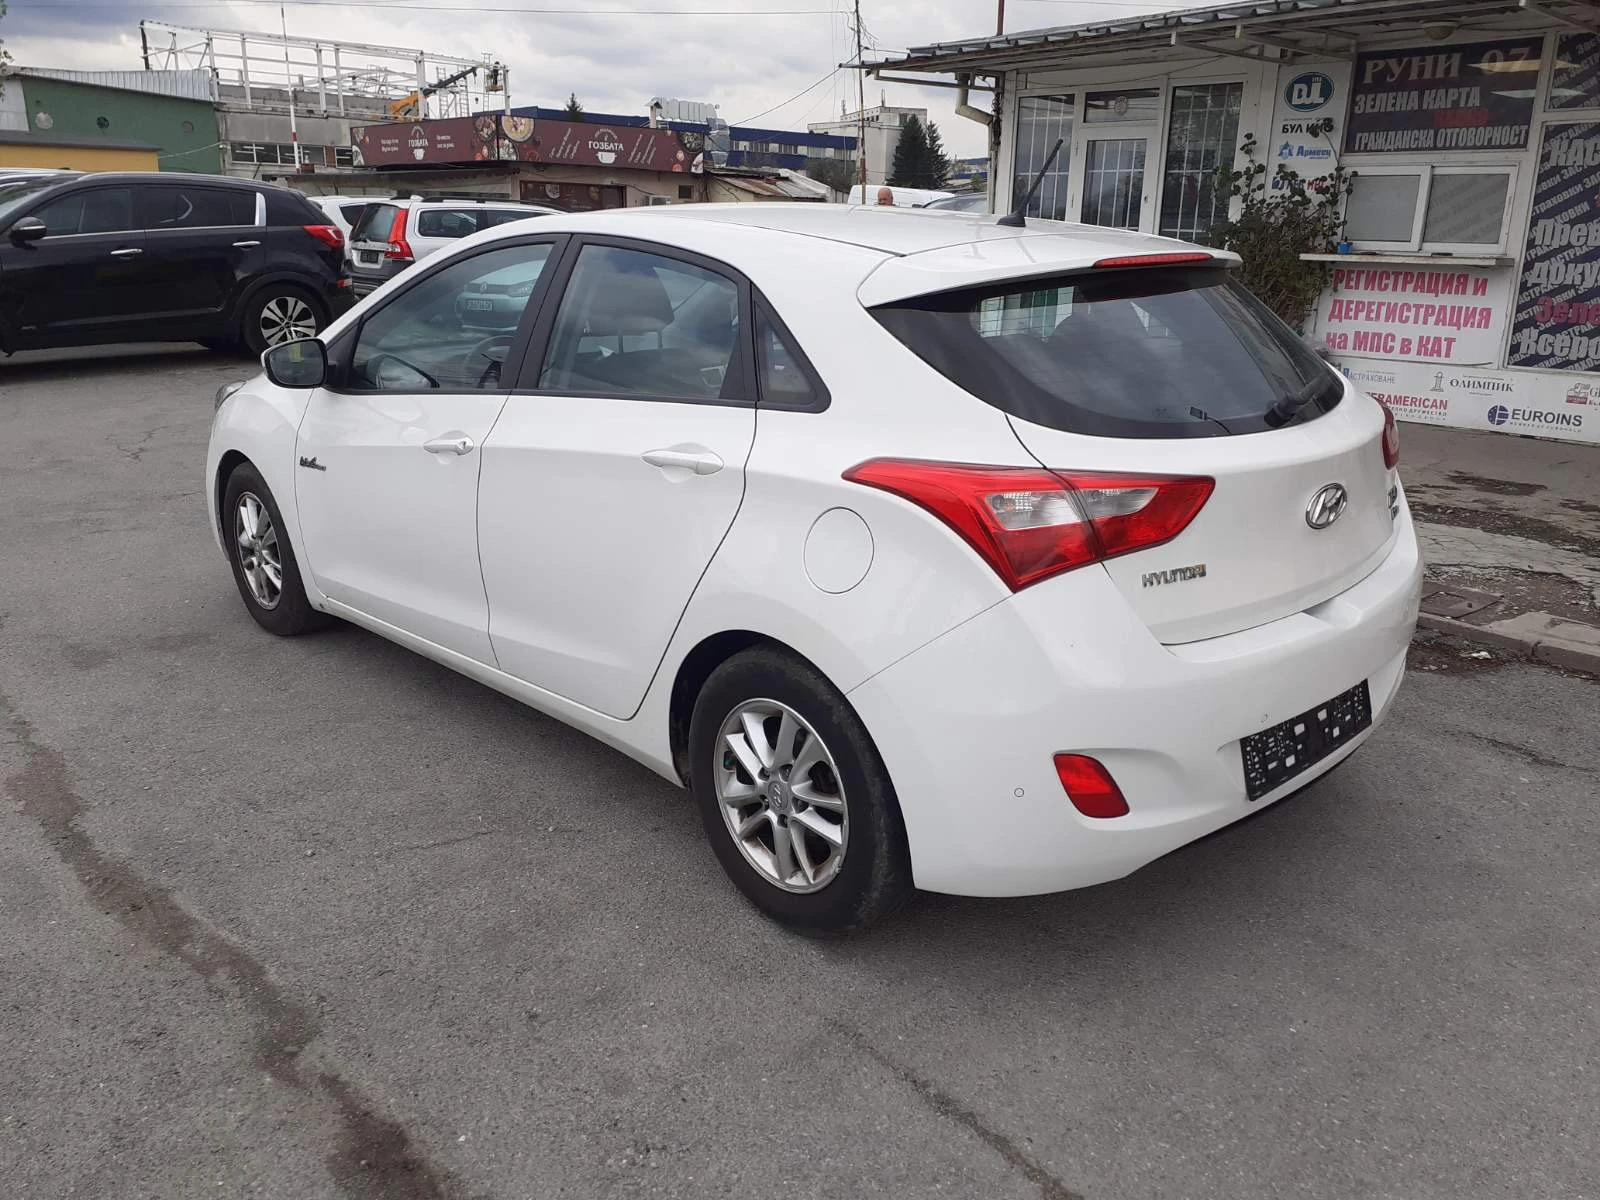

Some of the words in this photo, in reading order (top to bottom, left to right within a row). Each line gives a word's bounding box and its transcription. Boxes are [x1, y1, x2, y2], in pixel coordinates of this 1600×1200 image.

[1363, 53, 1463, 84] РУНИ
[1354, 91, 1418, 114] ЗЕЛЕНА
[1422, 87, 1480, 110] КАРТА
[1281, 123, 1303, 134] БУЛ
[1354, 128, 1434, 151] ГРАЖДАНСКА
[1436, 125, 1529, 148] ОТГОВОРНОСТ
[588, 141, 624, 151] ГОЗБАТА
[1333, 268, 1469, 297] РЕГИСТРАЦИЯ
[1472, 278, 1488, 297] и
[1328, 299, 1492, 331] ДЕРЕГИСТРАЦИЯ
[1326, 331, 1348, 350] на
[1352, 331, 1396, 354] МПС
[1400, 338, 1412, 355] в
[1416, 336, 1456, 359] КАТ
[1450, 379, 1514, 392] ОЛИМПИК
[1511, 409, 1583, 427] EUROINS
[1142, 564, 1206, 588] HYUNDAI
